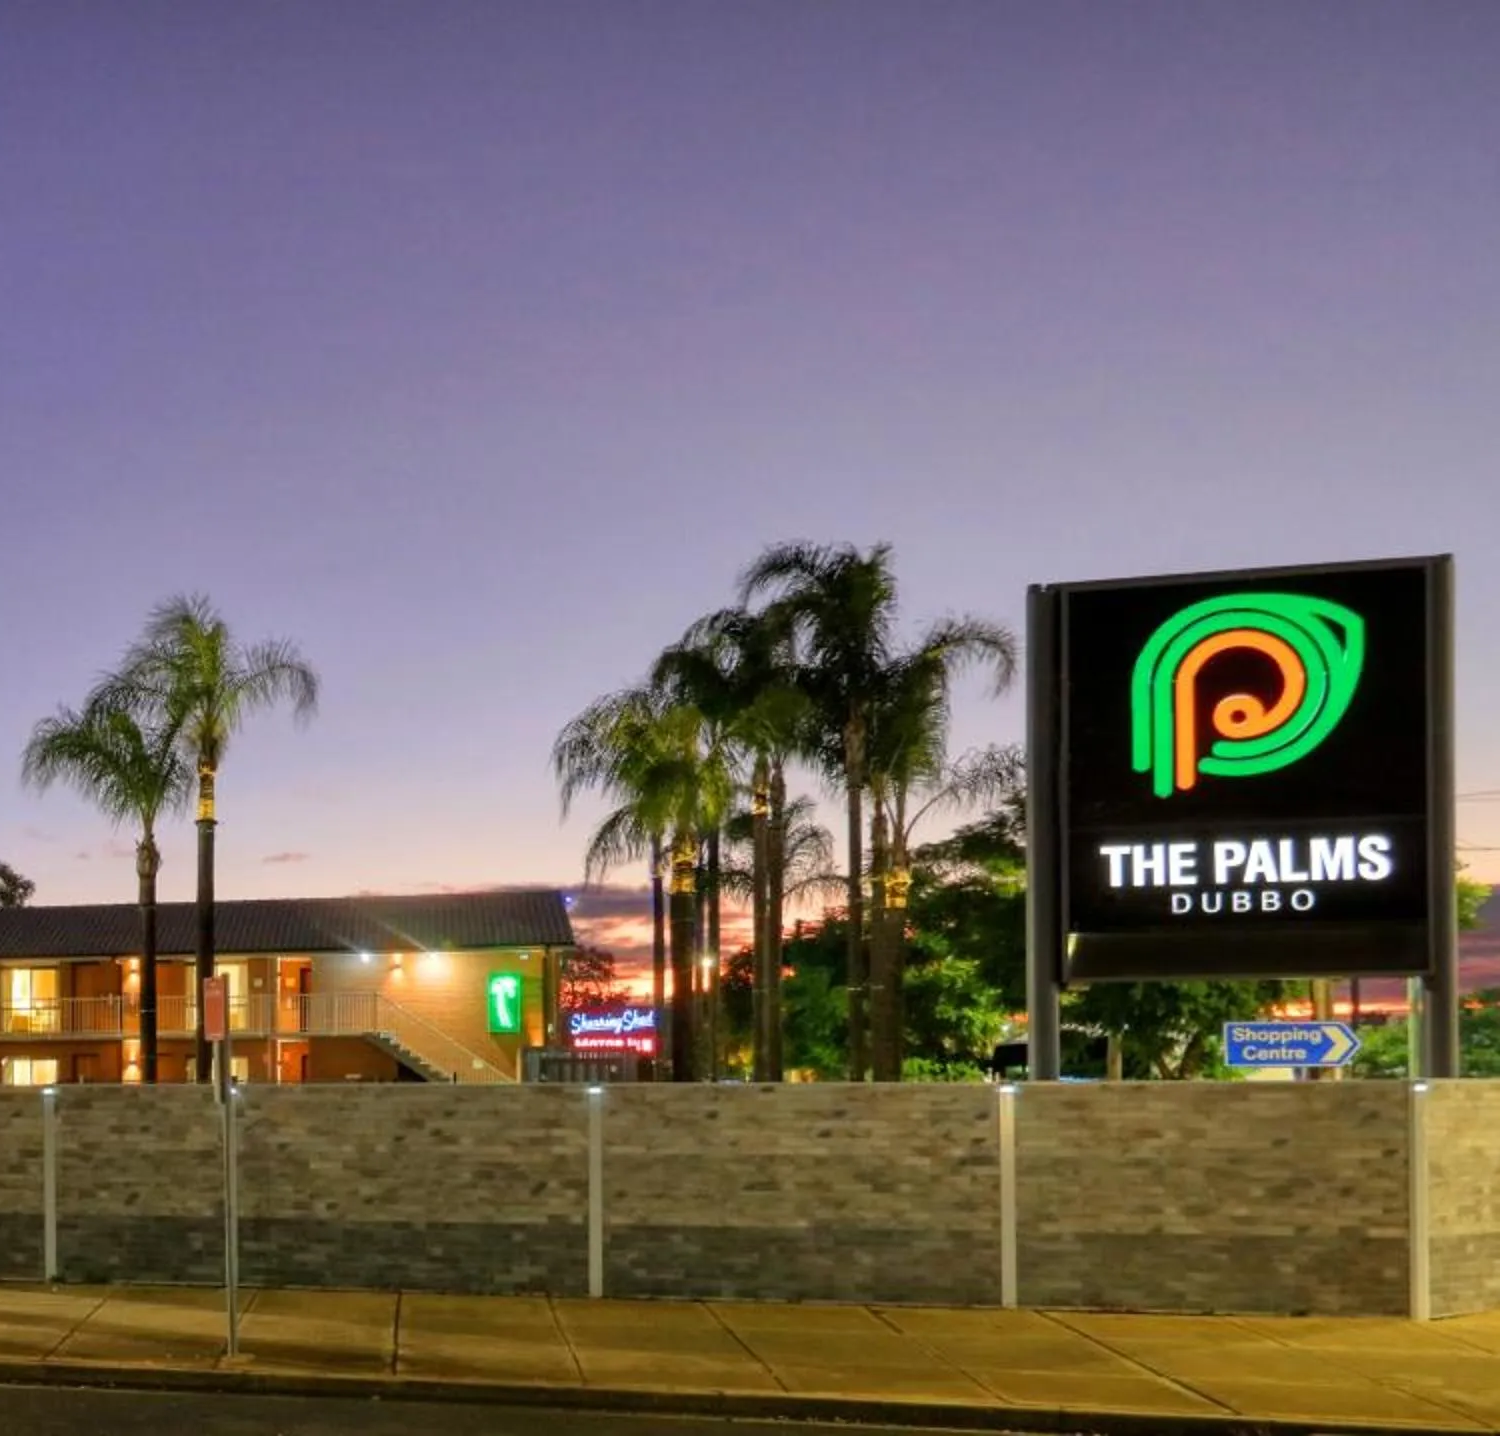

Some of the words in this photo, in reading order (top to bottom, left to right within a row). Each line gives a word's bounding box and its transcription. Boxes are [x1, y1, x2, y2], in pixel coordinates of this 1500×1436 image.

[1099, 843, 1198, 888] THE
[1213, 834, 1393, 886] PALMS
[1170, 888, 1316, 914] DUBBO
[1232, 1026, 1322, 1046] Shopping
[1242, 1044, 1308, 1061] Centre
